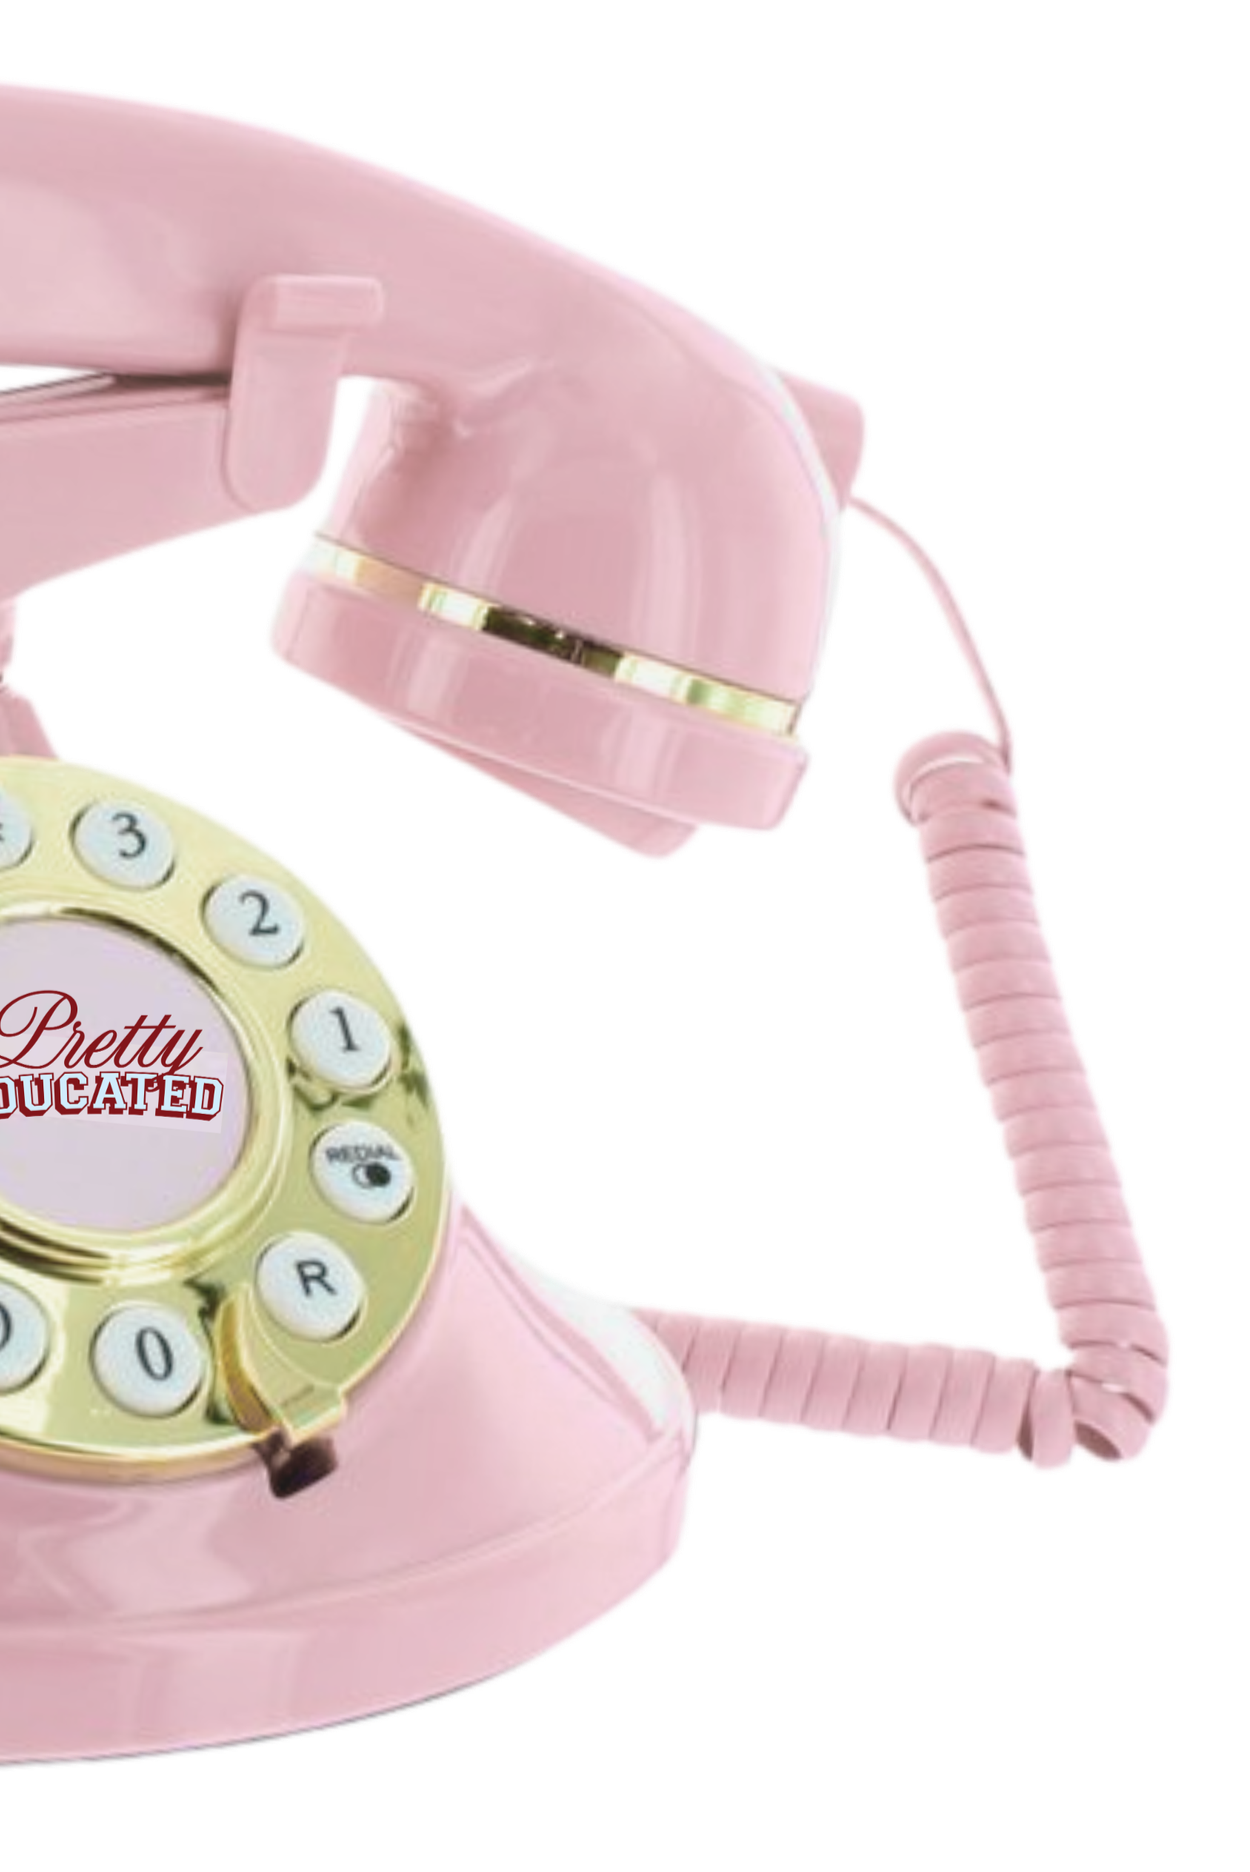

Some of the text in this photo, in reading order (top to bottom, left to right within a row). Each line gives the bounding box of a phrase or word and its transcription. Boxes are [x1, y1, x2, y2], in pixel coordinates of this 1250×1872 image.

[115, 813, 147, 859] 3
[241, 891, 279, 936] 2
[332, 1007, 358, 1052] 1
[326, 1144, 401, 1163] REDIAL
[296, 1260, 335, 1296] R
[136, 1328, 173, 1381] 0
